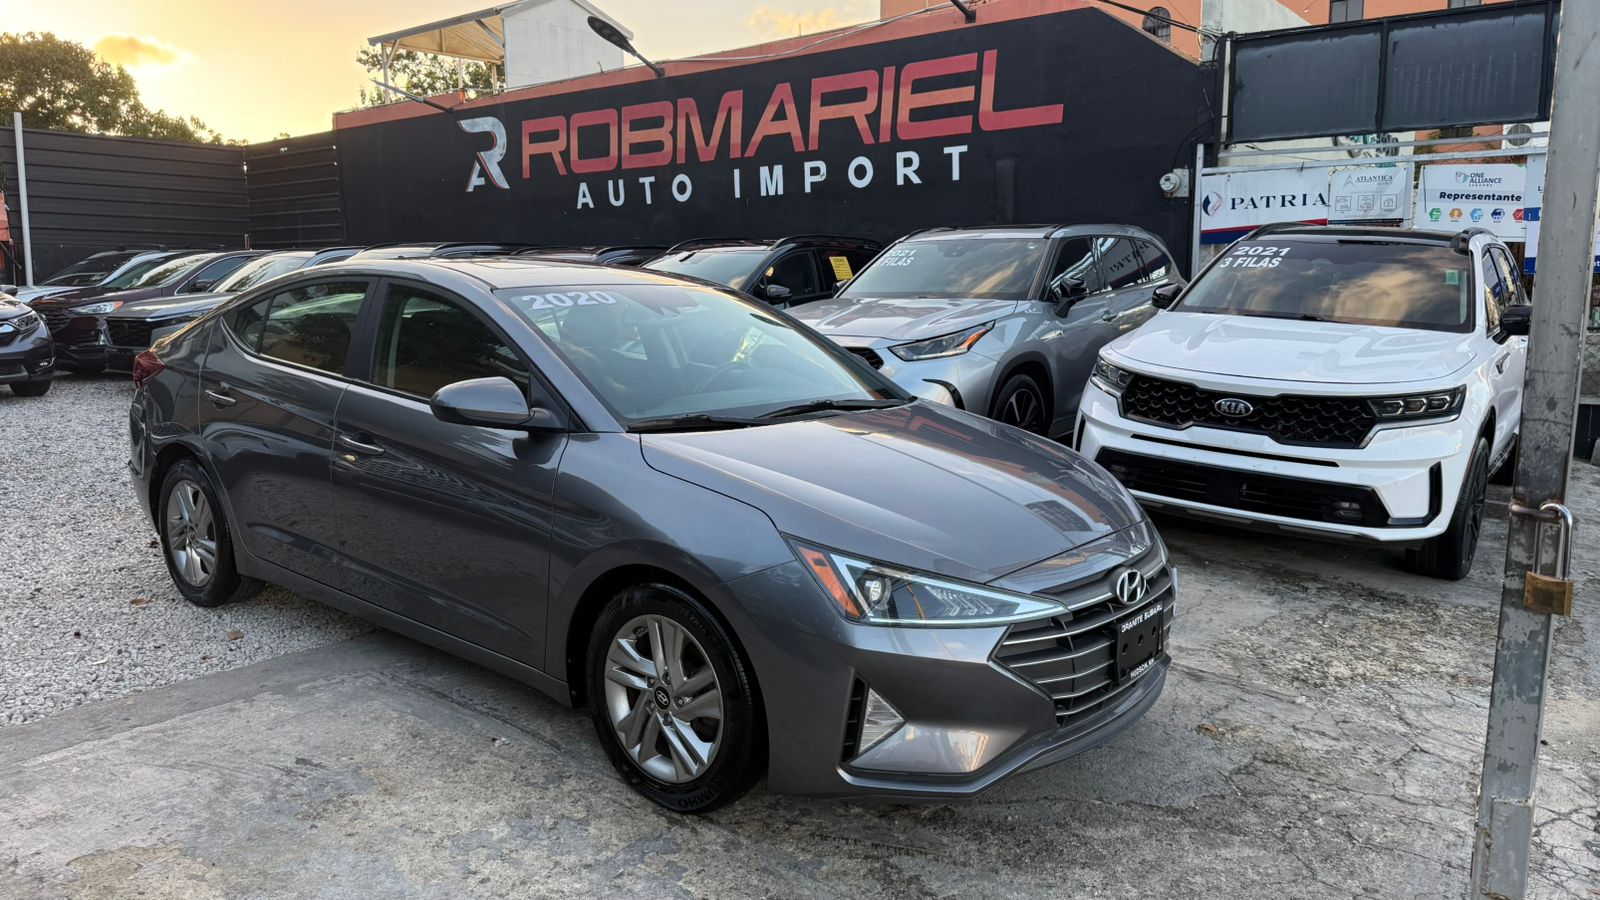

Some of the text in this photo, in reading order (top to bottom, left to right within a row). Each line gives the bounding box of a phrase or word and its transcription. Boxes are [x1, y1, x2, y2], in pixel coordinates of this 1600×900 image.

[522, 49, 1064, 178] ROBMARIEL
[576, 145, 968, 209] AUTO IMPORT
[1230, 192, 1327, 210] PATRIA
[1439, 191, 1522, 202] Representante
[1232, 246, 1292, 257] 2021
[880, 257, 914, 267] FILAS
[1220, 256, 1283, 268] 3 FILAS
[520, 290, 617, 310] 2020
[1220, 401, 1246, 415] KIA
